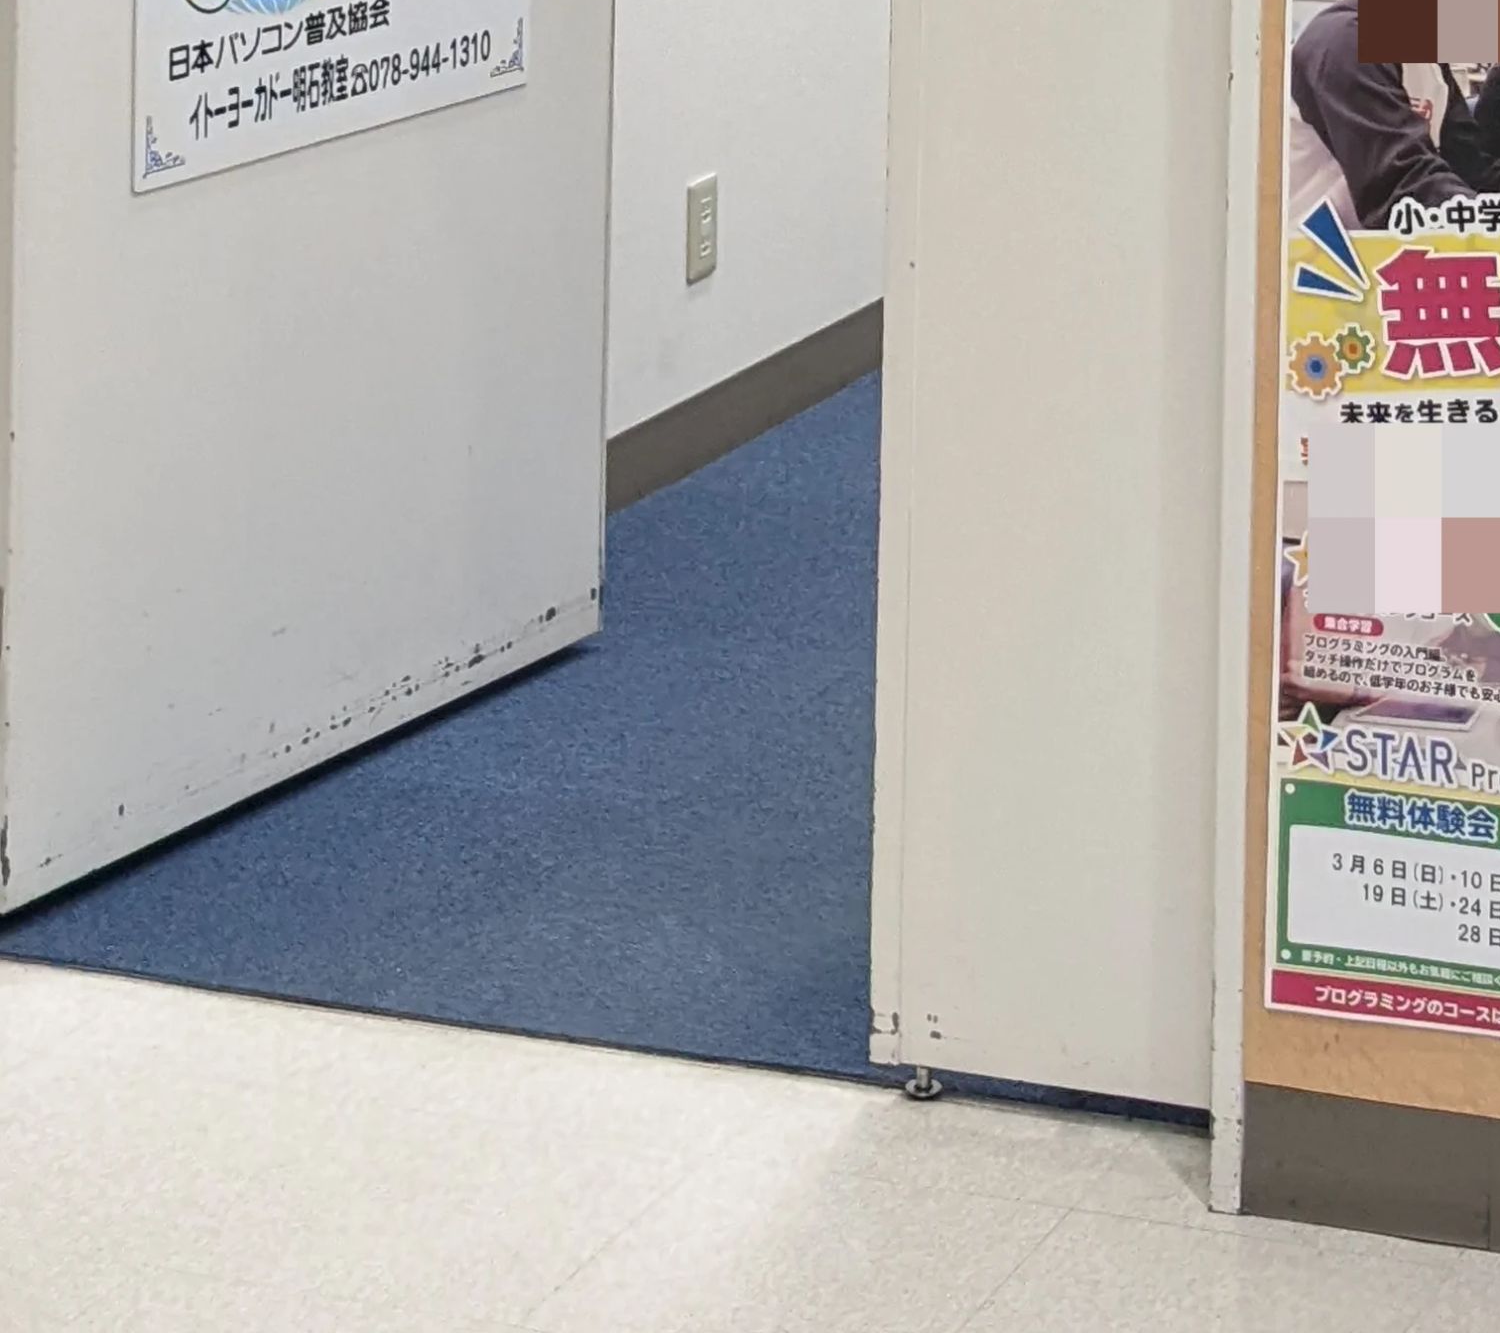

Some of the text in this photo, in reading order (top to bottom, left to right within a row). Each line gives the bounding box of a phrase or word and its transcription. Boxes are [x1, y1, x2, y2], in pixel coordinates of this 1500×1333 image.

[1304, 650, 1477, 683] タッチ操作だけでプログラムを
[1345, 729, 1455, 784] STAR
[1345, 793, 1497, 840] 無料体験会
